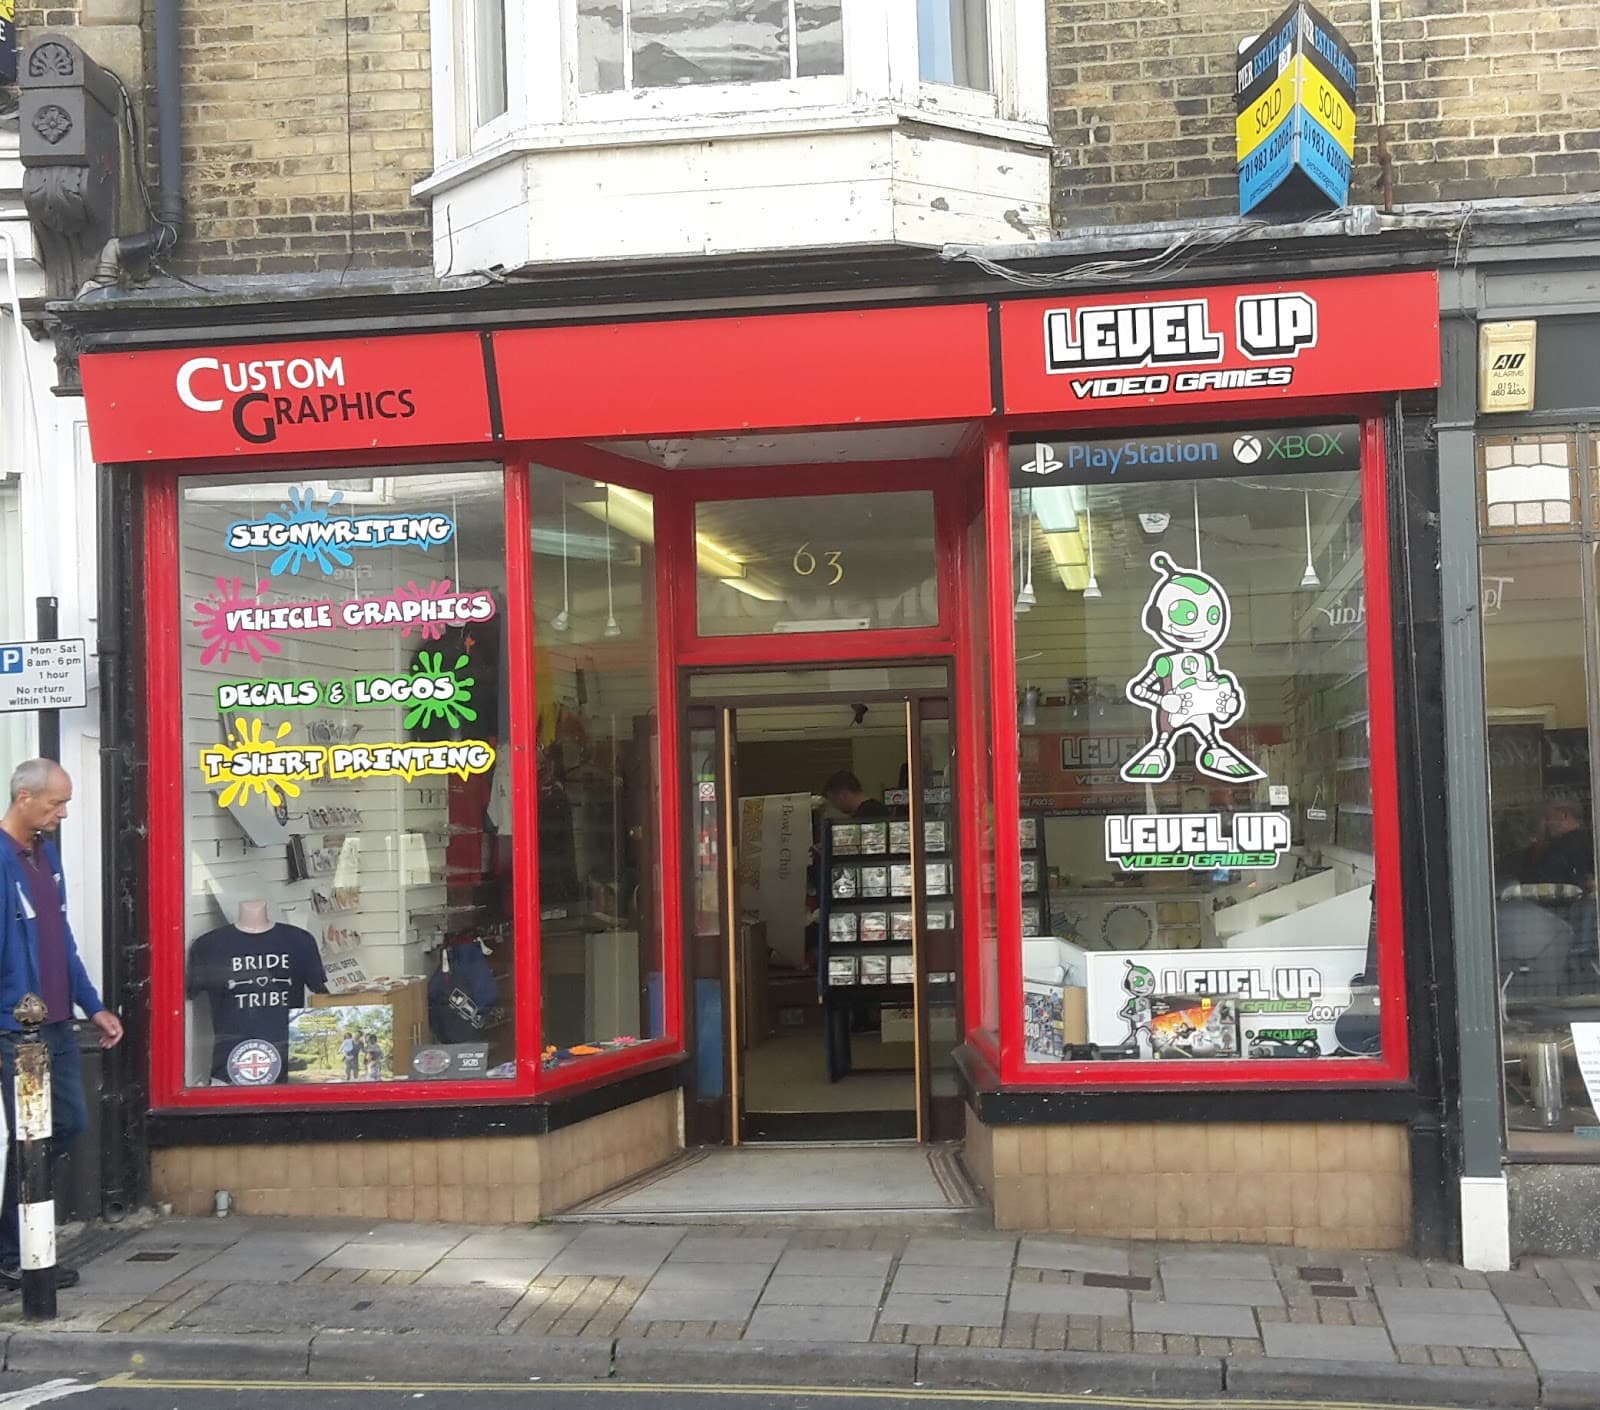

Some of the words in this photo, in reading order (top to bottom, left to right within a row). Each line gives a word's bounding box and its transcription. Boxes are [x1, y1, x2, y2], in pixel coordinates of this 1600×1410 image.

[1315, 25, 1338, 69] ESTATE
[1238, 60, 1254, 94] PIER
[1255, 87, 1282, 135] SOLD
[1319, 85, 1343, 131] SOLD
[1303, 120, 1325, 157] 01983
[1245, 148, 1267, 183] 01983
[1046, 300, 1223, 373] LEVEL
[1237, 293, 1317, 359] UP
[176, 357, 345, 412] CUSTOM
[1072, 374, 1168, 398] VIDEO
[1174, 367, 1293, 392] GAMES
[1493, 370, 1524, 378] ALARMS
[232, 389, 415, 443] GRAPHICS
[1068, 441, 1218, 474] PlayStation
[1267, 432, 1344, 461] XBOX
[229, 516, 451, 549] SIGNWRITING
[225, 604, 332, 632] VEHICLE
[342, 595, 492, 627] GRAPHICS
[3, 650, 20, 672] P
[30, 646, 51, 655] Mon
[60, 645, 77, 653] Sat
[16, 686, 30, 694] No
[34, 686, 65, 694] return
[46, 671, 69, 679] hour
[219, 680, 318, 708] DECALS
[329, 680, 345, 704] &
[355, 675, 455, 704] LOGOS
[9, 697, 39, 705] within
[50, 695, 72, 703] hour
[205, 750, 324, 777] T-SHIRT
[334, 744, 491, 773] PRINTING
[1107, 813, 1231, 856] LEVEL
[1232, 813, 1290, 852] UP
[1119, 853, 1190, 868] VIDEO
[1193, 851, 1277, 867] GAMES
[231, 954, 290, 972] BRIDE
[235, 990, 289, 1008] TRIBE
[1275, 968, 1322, 999] UP
[1241, 999, 1312, 1013] GAMES
